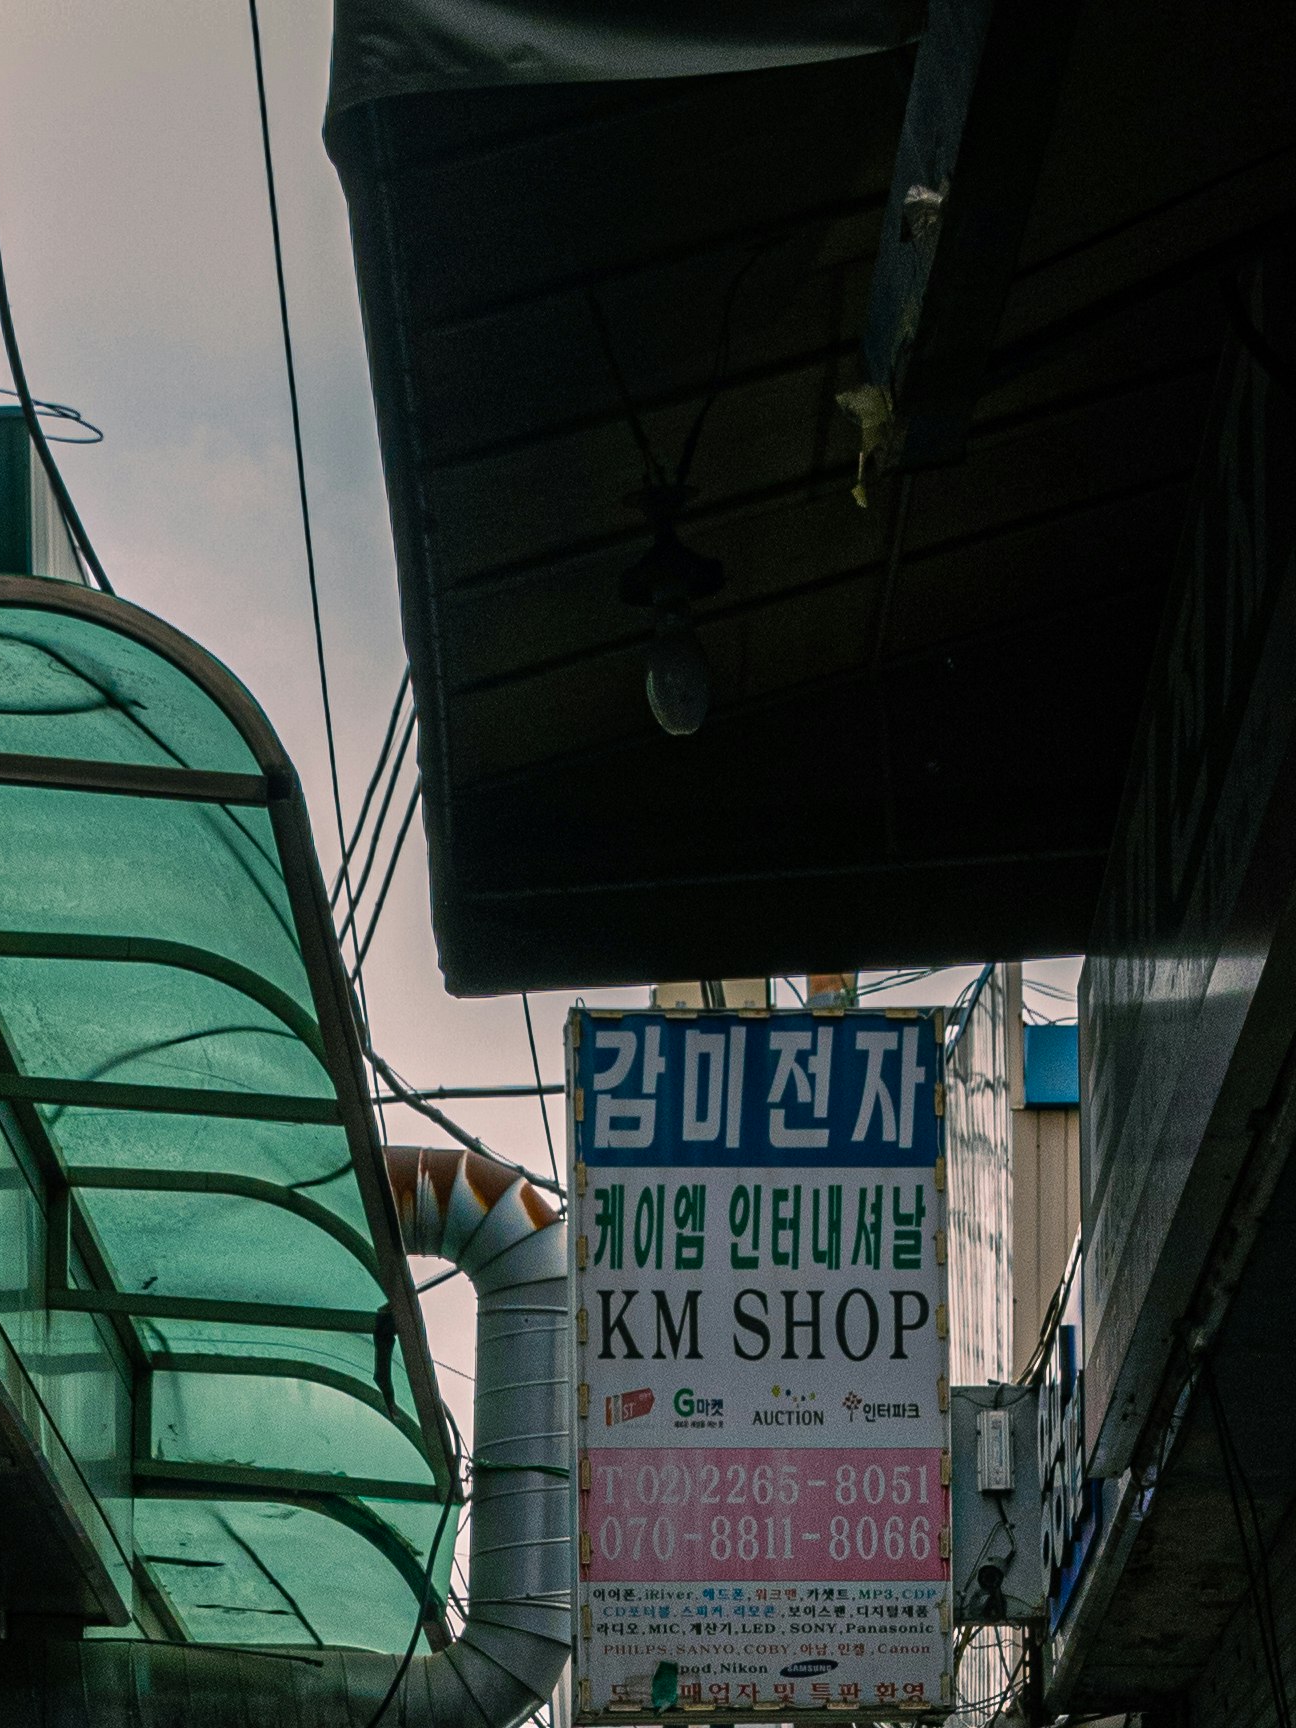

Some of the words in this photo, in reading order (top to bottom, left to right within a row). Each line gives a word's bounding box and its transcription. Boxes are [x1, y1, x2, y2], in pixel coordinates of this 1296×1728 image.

[592, 1025, 925, 1151] 감미전자
[593, 1184, 706, 1271] 케이엠
[729, 1183, 927, 1271] 인터내셔날
[596, 1289, 704, 1361] KM
[733, 1288, 931, 1361] SHOP
[753, 1410, 824, 1427] AUCTION
[862, 1402, 921, 1423] 인터파크
[600, 1515, 931, 1561] 070-8811-8066
[786, 1660, 834, 1674] SAMSUNG
